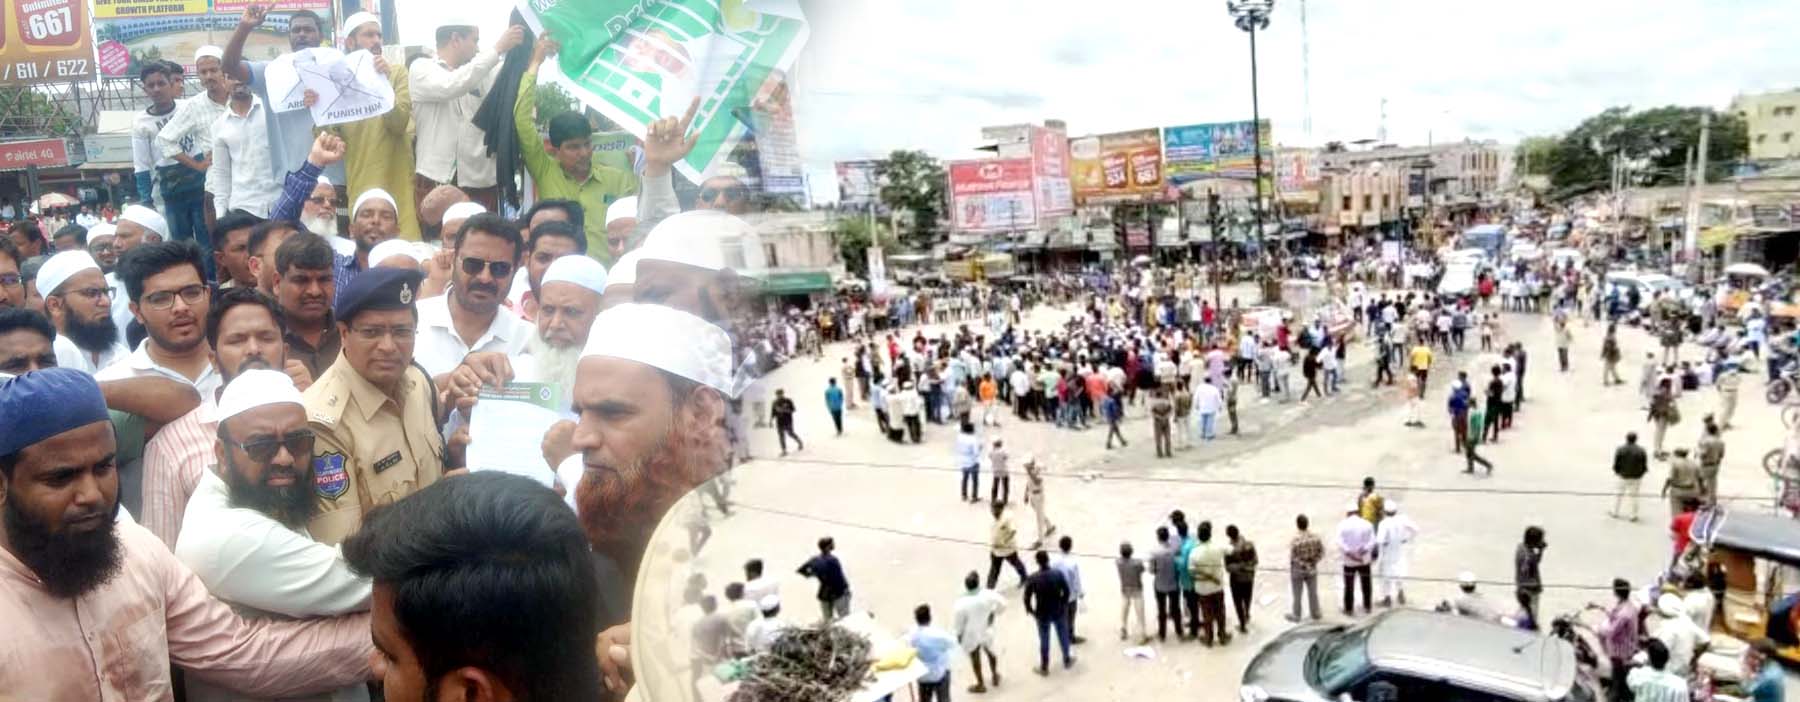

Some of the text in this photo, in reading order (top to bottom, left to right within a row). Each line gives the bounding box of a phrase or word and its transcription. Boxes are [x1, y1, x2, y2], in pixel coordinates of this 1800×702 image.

[116, 4, 185, 15] GROWTH PLATFORM
[29, 6, 73, 39] 667
[16, 61, 38, 79] 611
[57, 59, 88, 76] 622
[327, 102, 383, 119] PUNISH HIM
[14, 147, 54, 160] airtel 4G
[317, 473, 346, 484] POLICE
